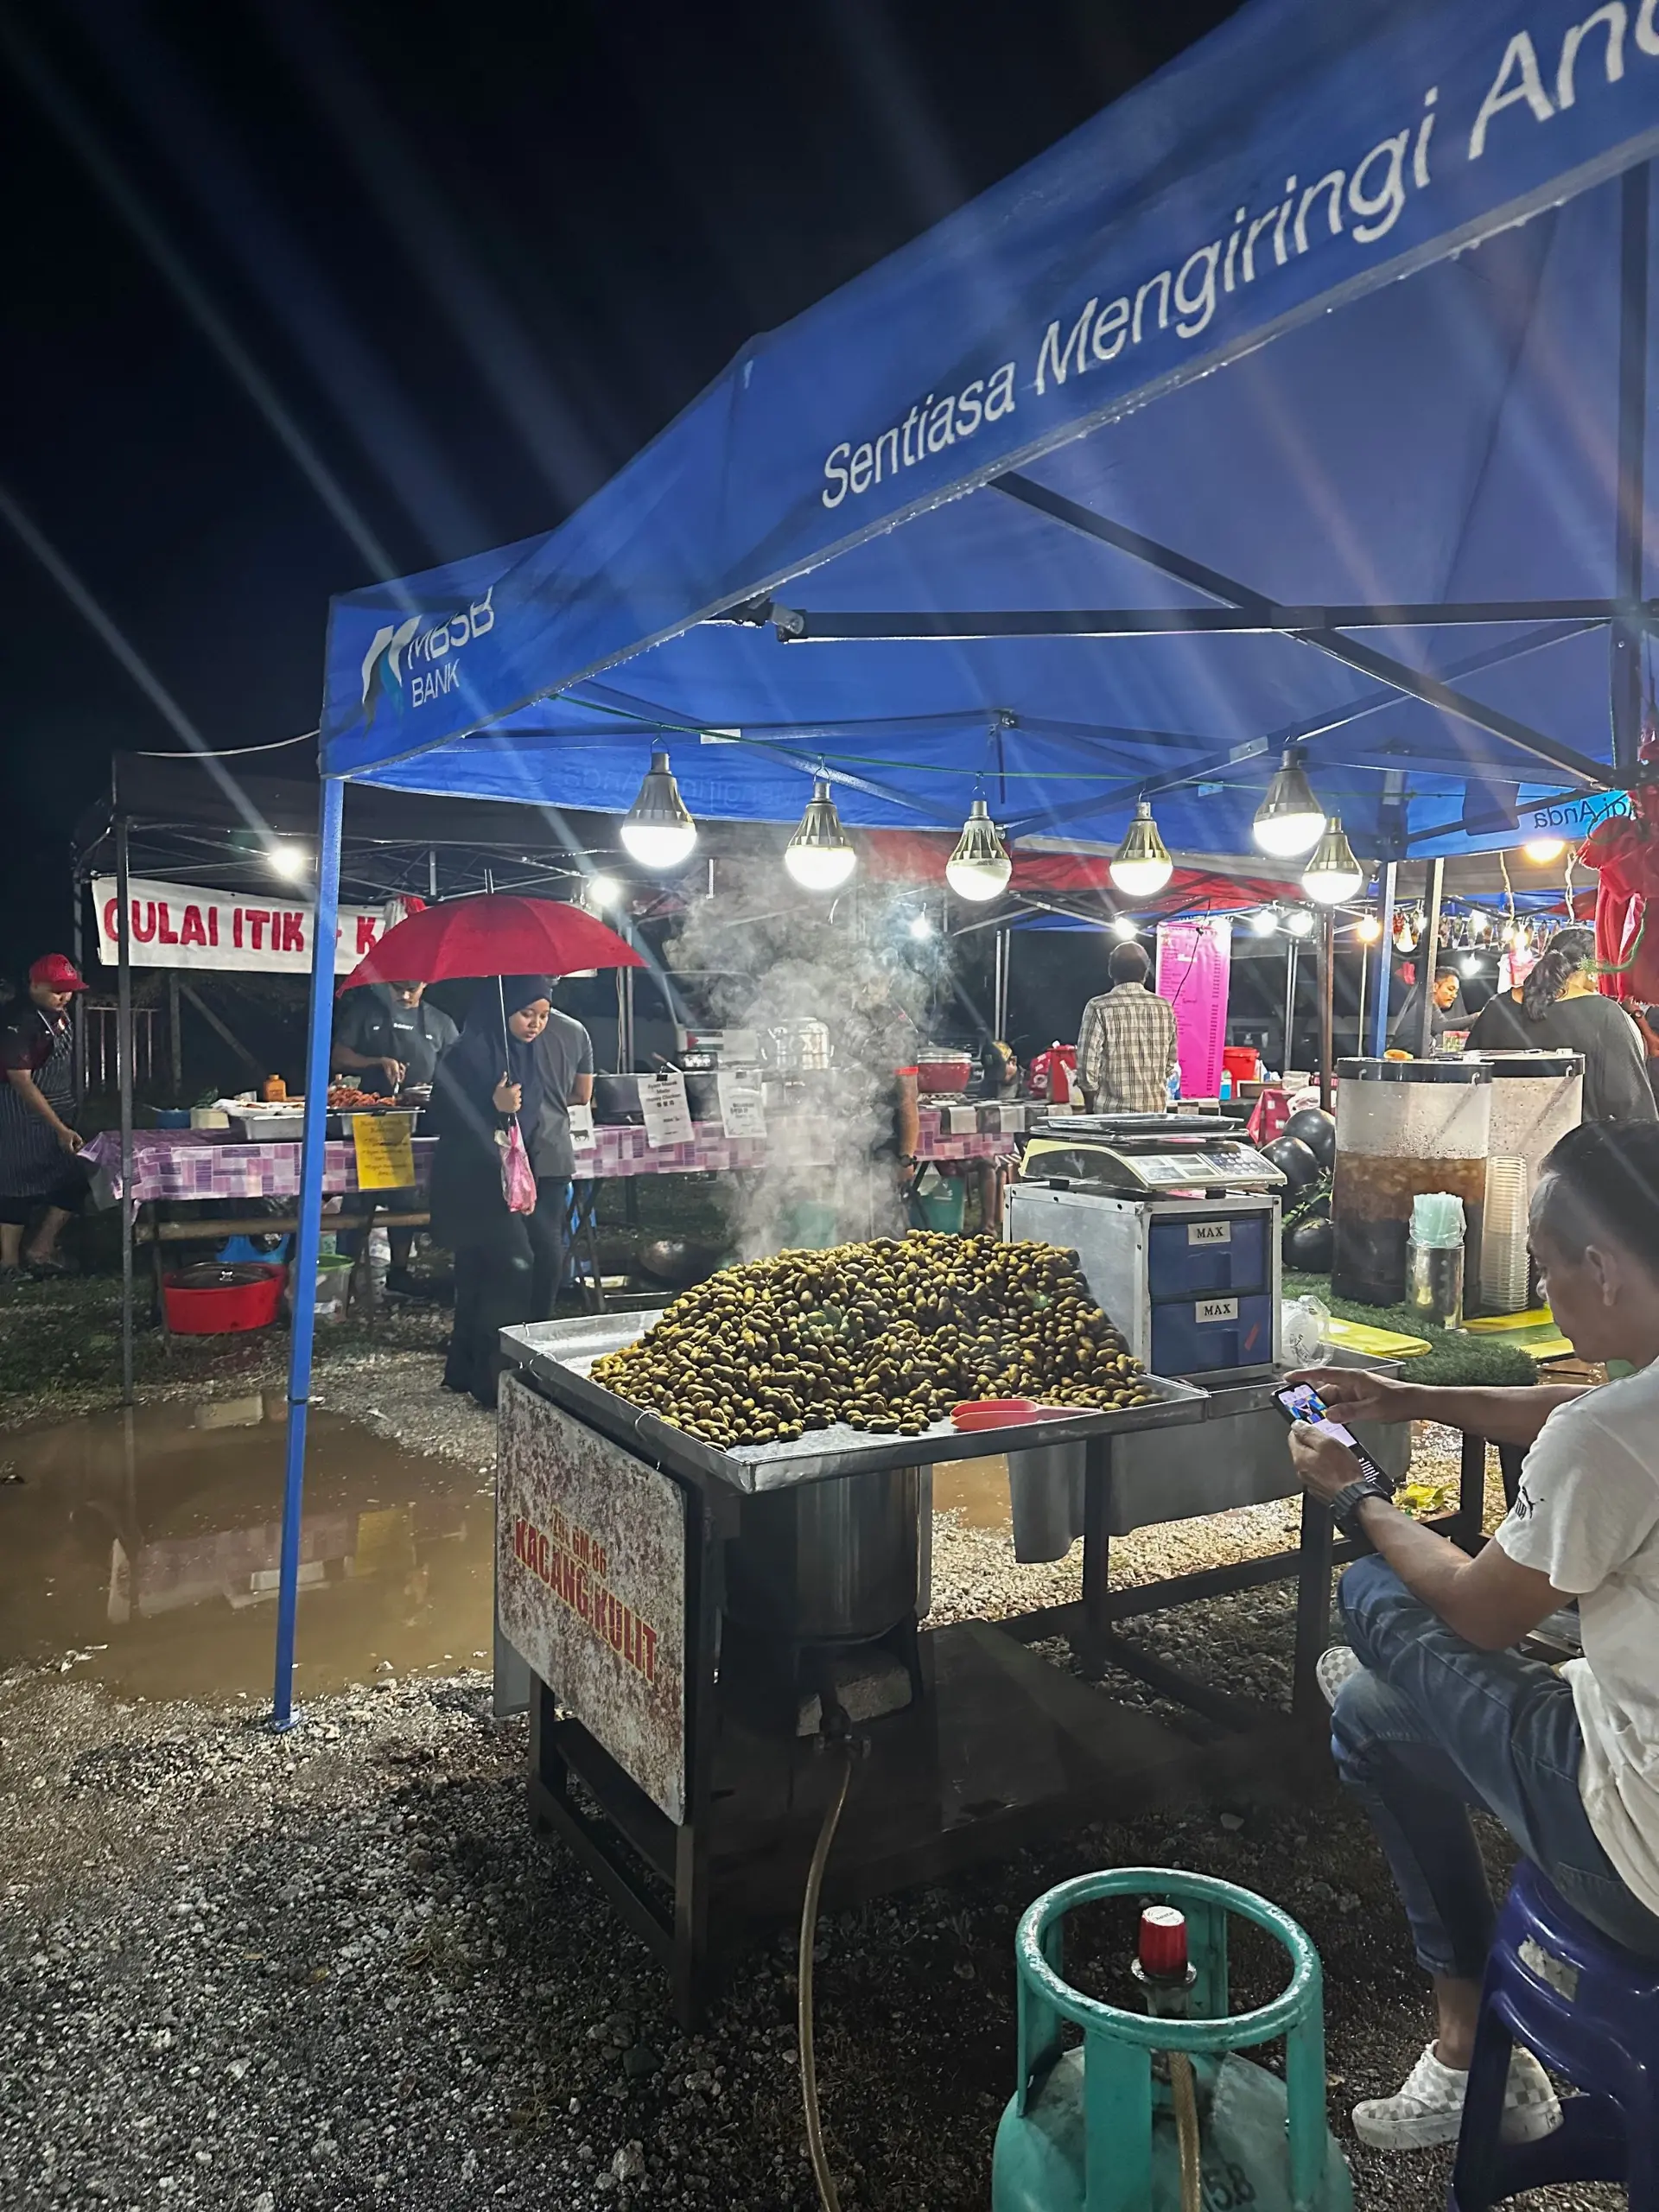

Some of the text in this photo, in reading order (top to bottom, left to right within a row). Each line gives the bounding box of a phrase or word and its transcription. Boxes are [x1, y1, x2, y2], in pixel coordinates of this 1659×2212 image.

[821, 0, 1659, 509] Sentiasa Mengiringi An
[411, 658, 461, 708] BANK
[232, 907, 305, 952] ITIK
[1196, 1226, 1224, 1239] MAX
[1204, 1303, 1231, 1317] MAX
[513, 1514, 658, 1685] KACANG KULIT
